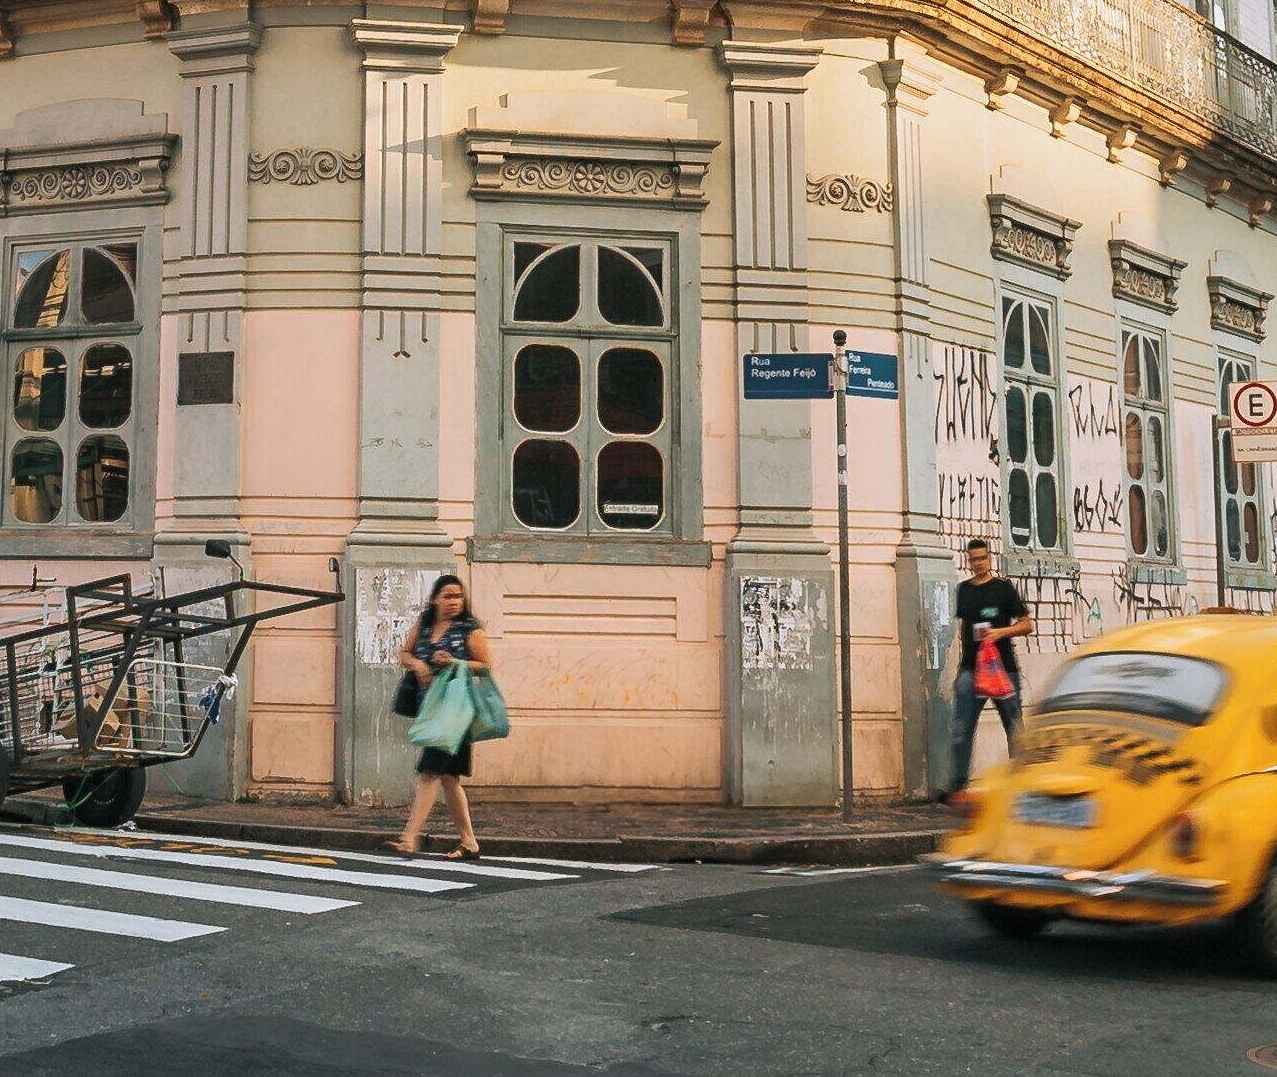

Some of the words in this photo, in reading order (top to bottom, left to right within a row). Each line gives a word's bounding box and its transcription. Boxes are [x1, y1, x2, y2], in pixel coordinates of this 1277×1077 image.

[751, 357, 771, 366] Rua
[849, 353, 861, 363] Rua
[751, 369, 791, 380] Regente
[793, 367, 817, 379] Feijó
[849, 365, 872, 375] Ferreira
[867, 378, 895, 389] Penteado
[1249, 394, 1263, 416] E
